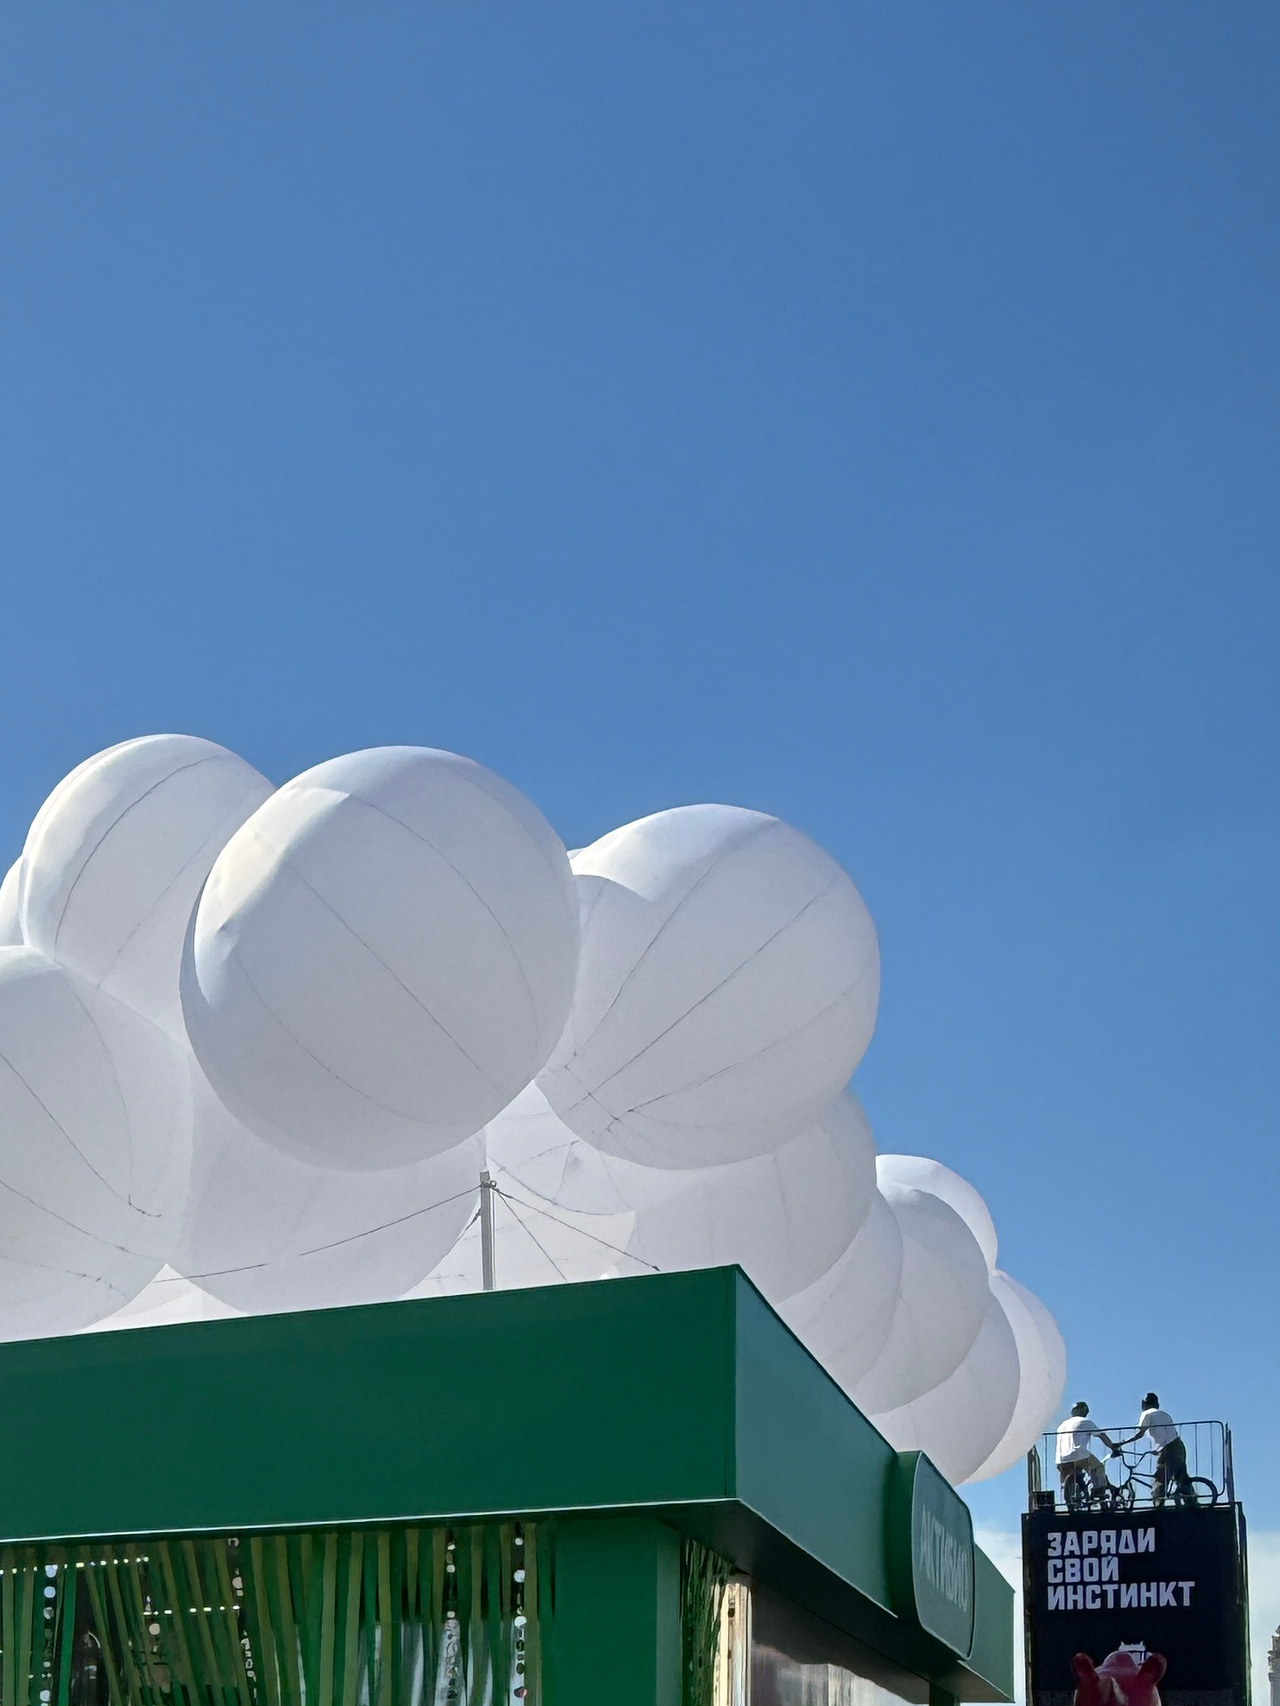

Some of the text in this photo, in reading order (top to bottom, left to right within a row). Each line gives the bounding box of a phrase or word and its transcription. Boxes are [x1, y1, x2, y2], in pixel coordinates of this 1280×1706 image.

[1047, 1527, 1156, 1557] ЗАРЯДИ
[1047, 1555, 1119, 1584] СВОЙ
[1047, 1581, 1195, 1611] ИНСТИНКТ
